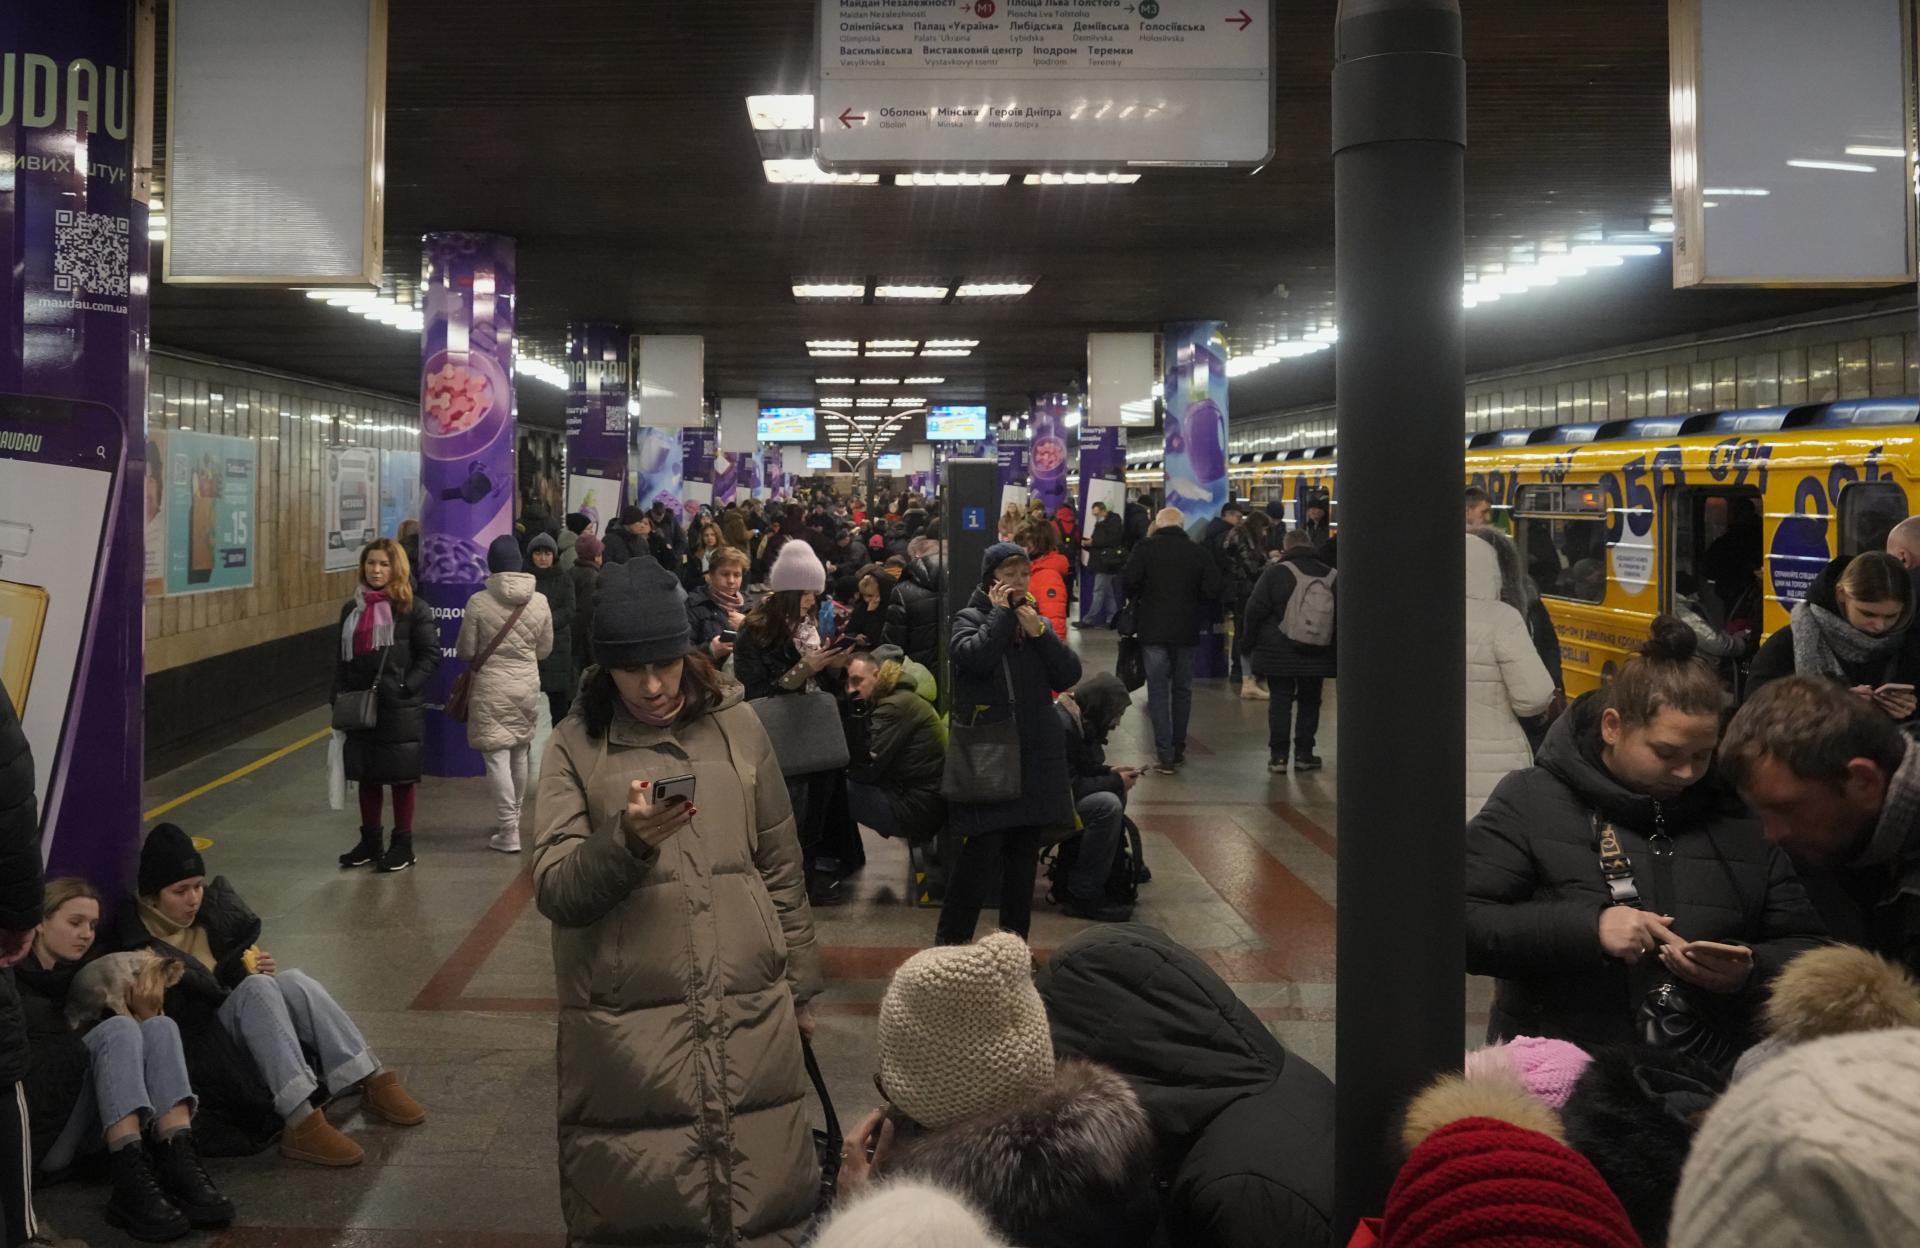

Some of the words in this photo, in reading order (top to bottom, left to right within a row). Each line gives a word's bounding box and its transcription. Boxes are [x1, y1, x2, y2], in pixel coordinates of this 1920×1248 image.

[840, 22, 904, 32] Олімпійська
[914, 22, 946, 33] Палац
[1009, 22, 1063, 33] Либідська
[1073, 22, 1130, 32] Деміївська
[1140, 22, 1206, 32] Голосіївська
[840, 46, 913, 56] Васильківська
[923, 46, 989, 55] Виставковий
[992, 48, 1024, 57] центр
[1033, 46, 1078, 56] Іподром
[1088, 46, 1134, 56] Теремки
[880, 107, 928, 118] Оболонь
[938, 106, 980, 117] Мінська
[989, 107, 1023, 118] Героїв
[1026, 106, 1062, 119] Дніпра
[39, 297, 128, 314] maudau.com.ua
